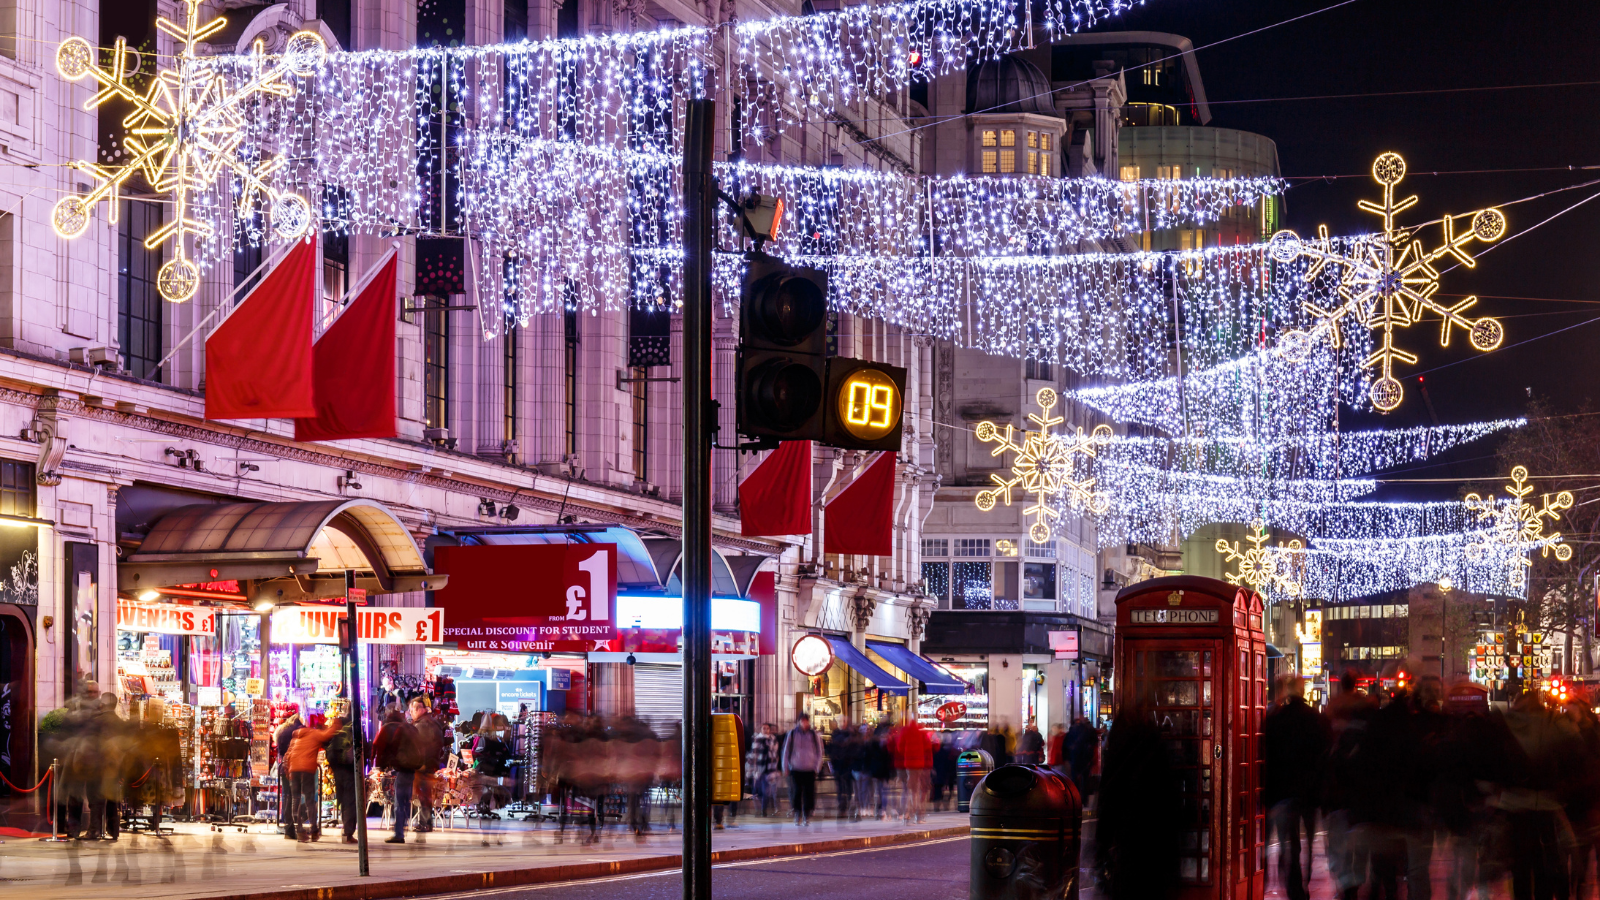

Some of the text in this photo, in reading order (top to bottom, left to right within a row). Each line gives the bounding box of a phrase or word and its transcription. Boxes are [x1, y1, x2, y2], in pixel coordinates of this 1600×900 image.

[847, 381, 894, 429] 09
[566, 550, 609, 621] £1
[202, 613, 215, 633] £1
[1133, 610, 1216, 623] TELPHONE
[415, 610, 441, 642] £1
[442, 625, 610, 636] SPECIAL DISCOUNT FOR STUDENT
[488, 640, 499, 650] &
[500, 639, 555, 650] Souvenir
[519, 690, 537, 698] tickets
[937, 703, 965, 720] SALE
